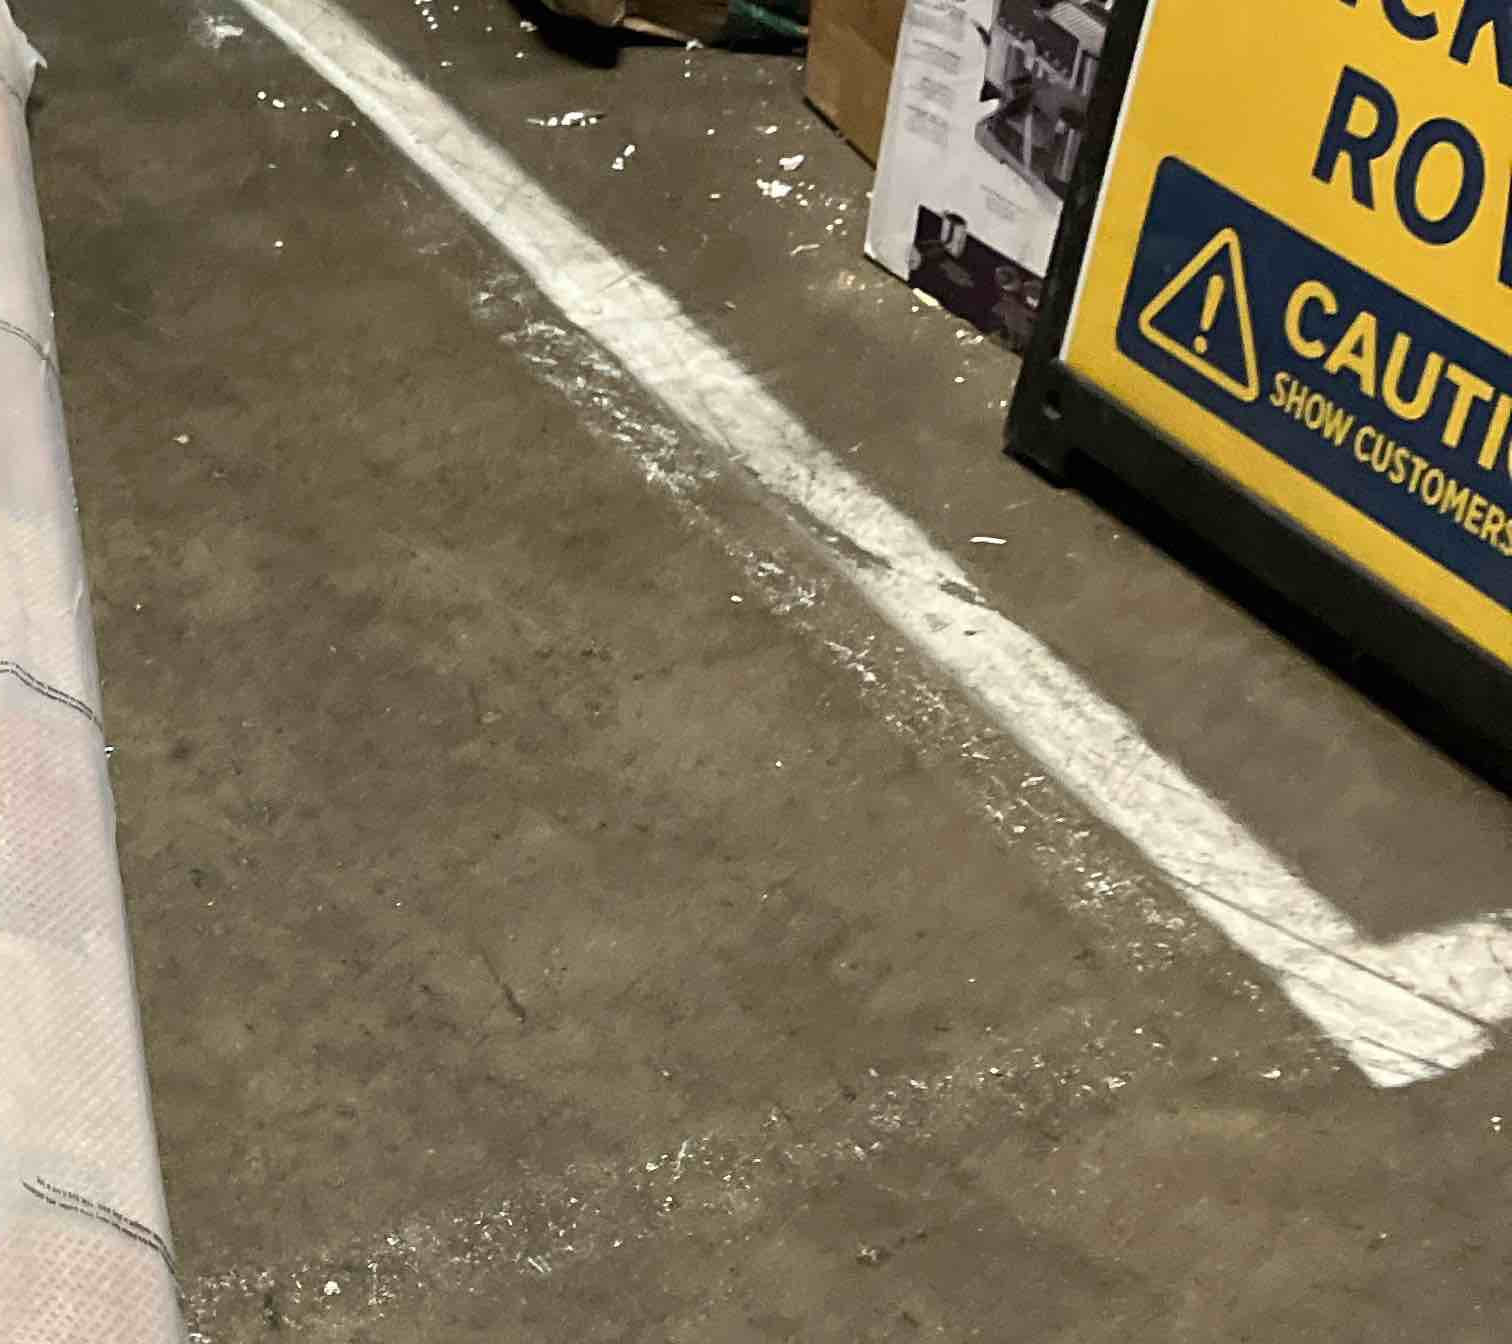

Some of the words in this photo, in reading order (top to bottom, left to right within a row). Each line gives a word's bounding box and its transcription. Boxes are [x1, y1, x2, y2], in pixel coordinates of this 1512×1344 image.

[1312, 64, 1512, 289] RO
[1269, 371, 1355, 447] SHOW
[1284, 279, 1512, 480] CAUTI
